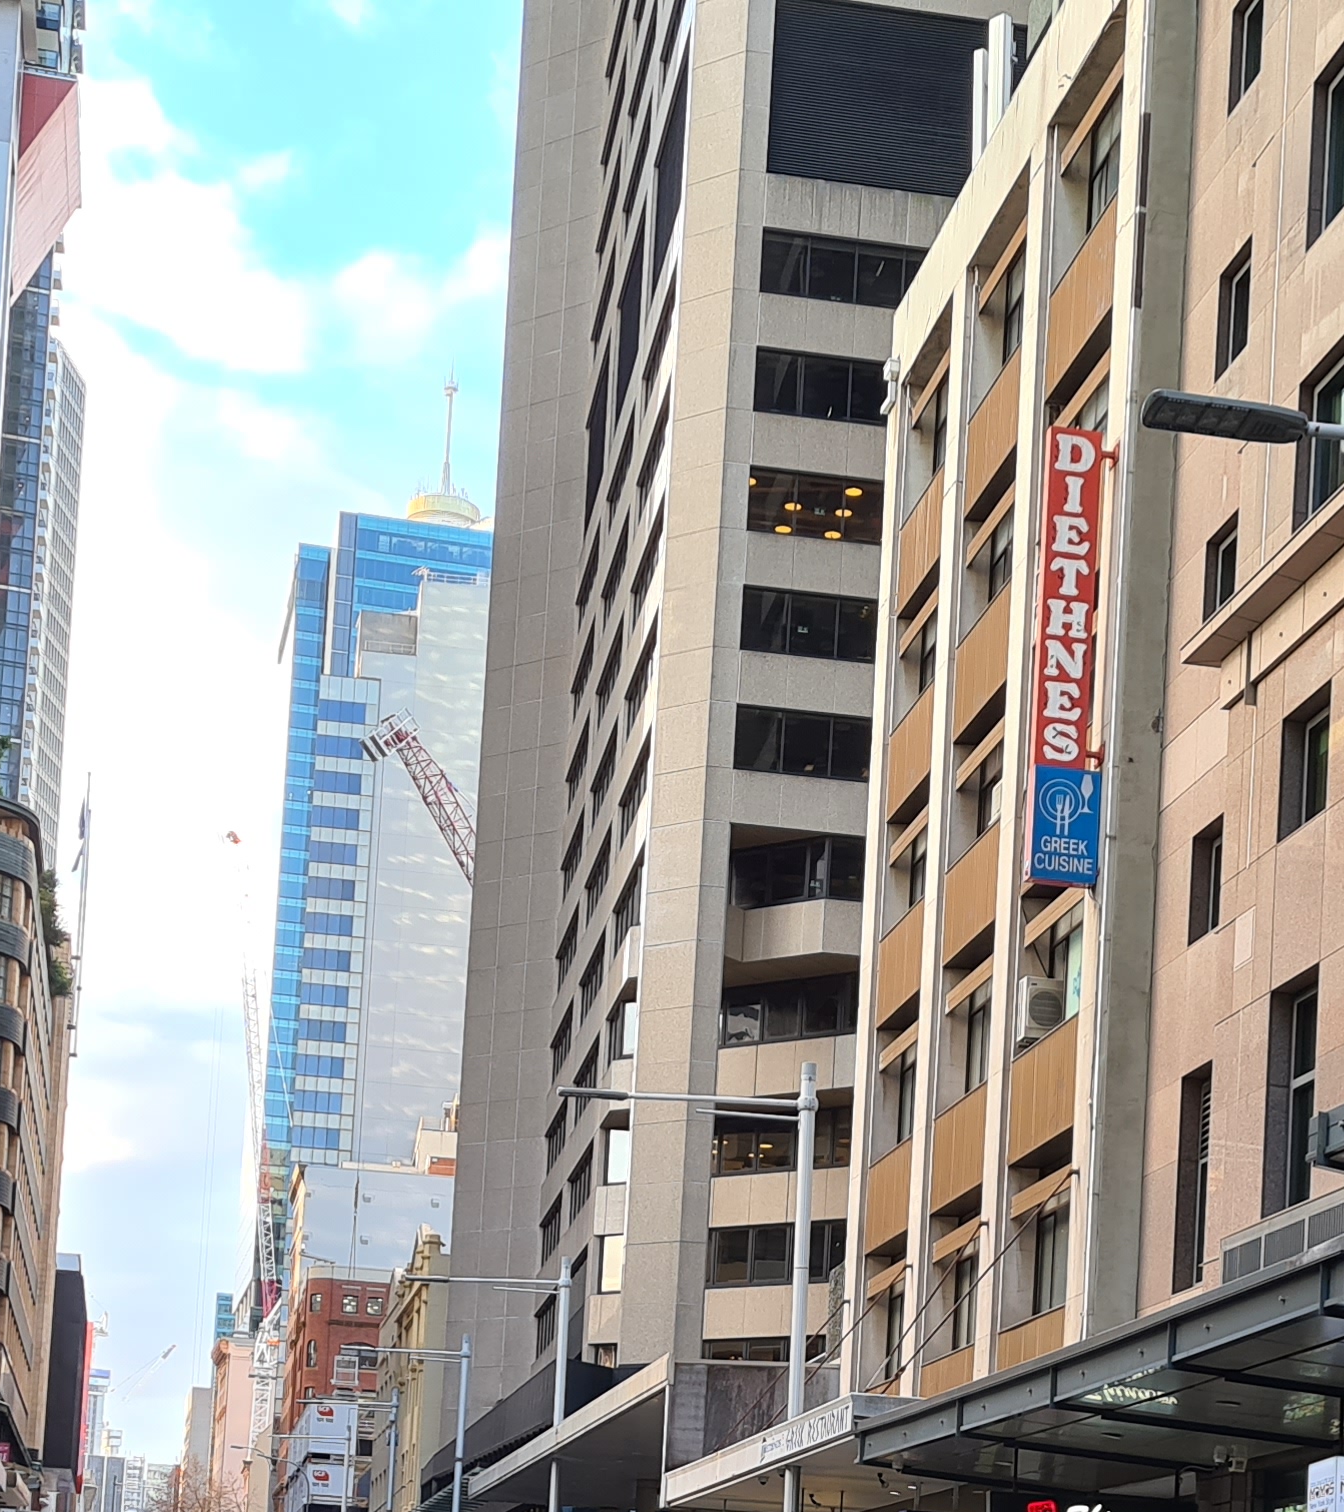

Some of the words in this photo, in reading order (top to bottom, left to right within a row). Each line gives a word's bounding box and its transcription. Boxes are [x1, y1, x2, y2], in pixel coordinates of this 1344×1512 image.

[1042, 432, 1096, 762] DIETHNES
[1040, 835, 1088, 856] GREEK
[1034, 852, 1094, 875] CUISINE
[806, 1405, 851, 1445] RESTAURANT
